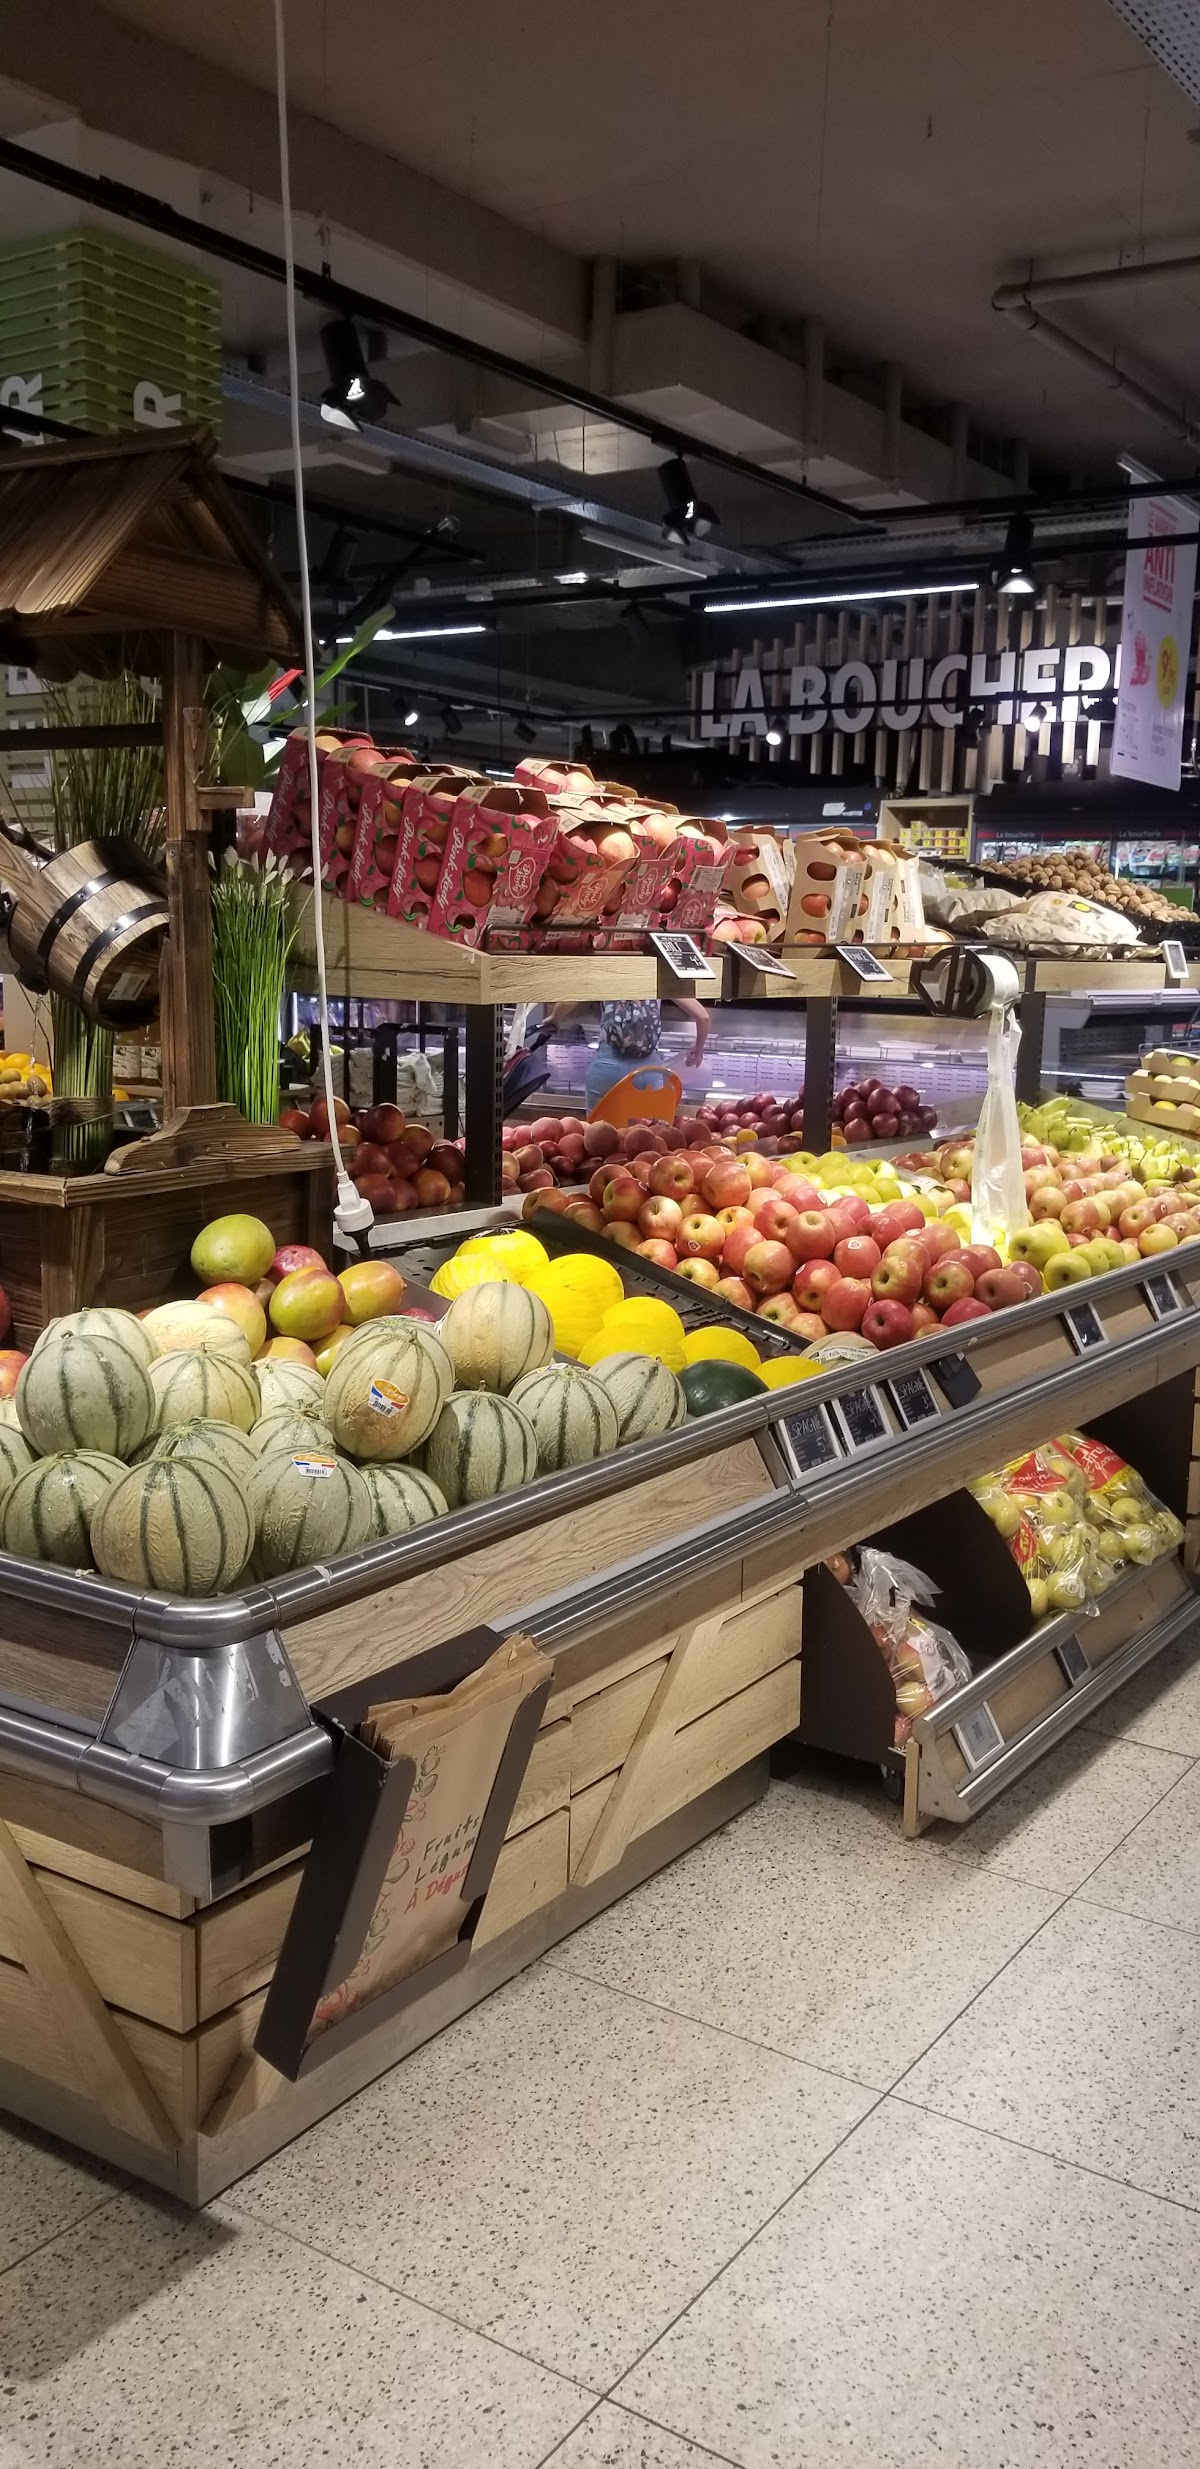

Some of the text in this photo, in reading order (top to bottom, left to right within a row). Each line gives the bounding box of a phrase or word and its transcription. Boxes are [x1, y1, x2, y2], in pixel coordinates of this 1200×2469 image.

[1143, 541, 1177, 585] ANTI
[701, 668, 768, 738] LA
[267, 764, 294, 843] Pink Lady
[319, 788, 336, 834] Pink
[350, 803, 374, 889] Pink Lady
[996, 831, 1036, 839] La boucherie
[1119, 830, 1162, 838] La boucherie
[392, 816, 415, 900] Pink Lady
[436, 827, 465, 911] Pink Lady
[511, 866, 523, 893] Lady
[519, 863, 532, 892] Pink
[841, 1397, 878, 1419] ESPAGNE
[894, 1376, 927, 1400] ESPAGNE
[786, 1413, 825, 1441] ESPAGNE
[423, 1814, 480, 1861] Fruits
[414, 1836, 476, 1885] Légum
[424, 1863, 470, 1902] Dégus
